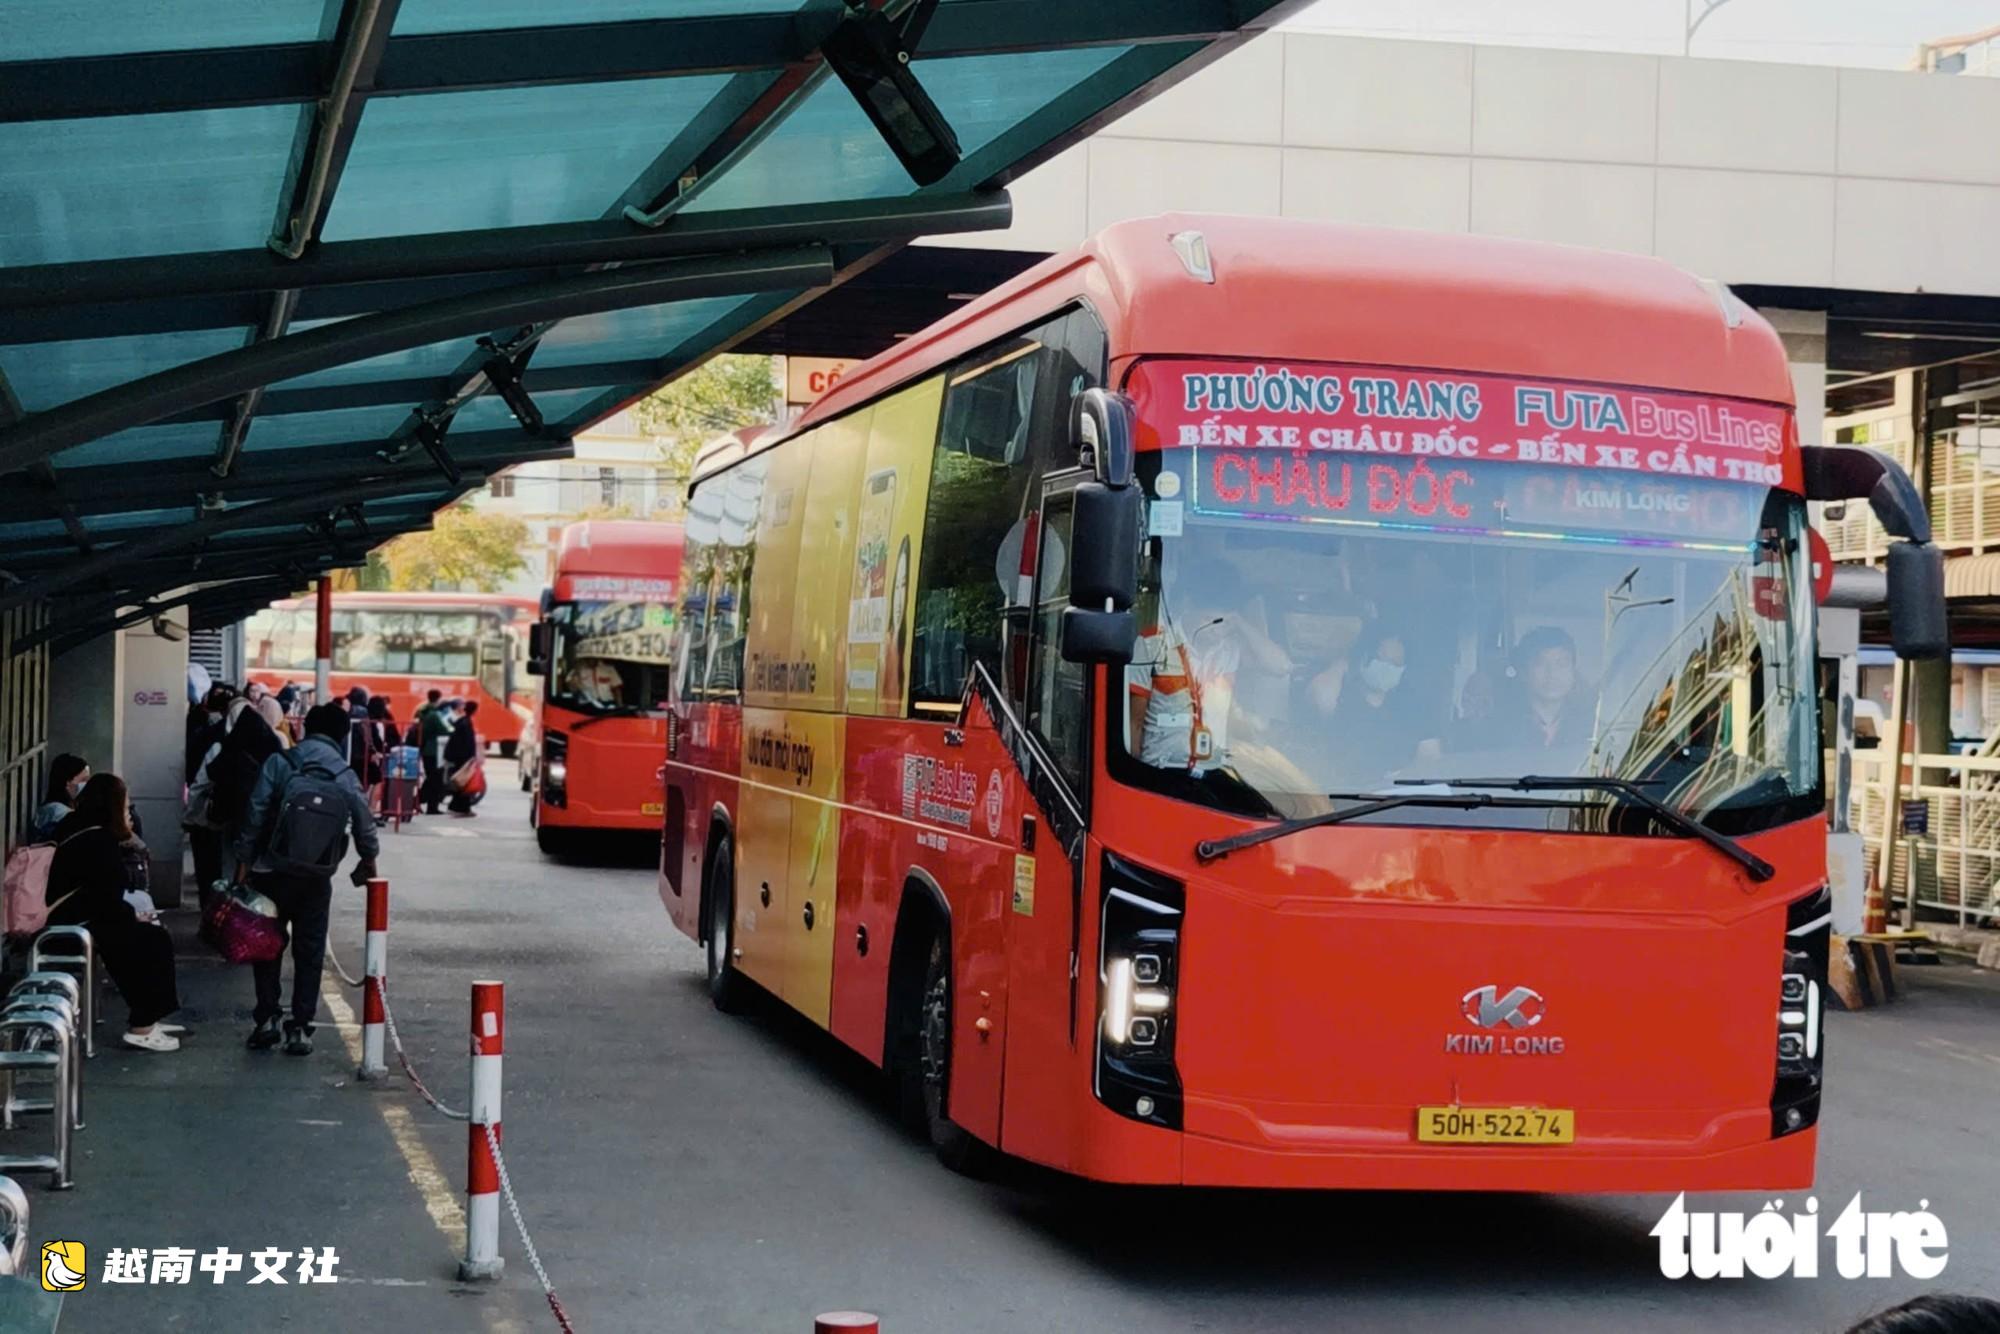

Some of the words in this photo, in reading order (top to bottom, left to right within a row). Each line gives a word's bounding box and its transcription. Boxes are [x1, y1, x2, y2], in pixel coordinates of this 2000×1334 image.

[1183, 367, 1343, 414] PHƯƠNG
[1350, 377, 1482, 421] TRANG
[1515, 386, 1630, 435] FUTA
[1631, 396, 1697, 442] Bus
[1697, 404, 1783, 454] Lines
[1178, 415, 1247, 446] BẾN
[1256, 425, 1301, 447] XE
[1309, 424, 1402, 452] CHÂU
[1411, 425, 1479, 457] ĐỐC
[1516, 432, 1588, 464] BẾN
[1595, 444, 1641, 470] XE
[1647, 444, 1716, 477] CẦN
[1723, 457, 1784, 485] THƠ
[1576, 489, 1620, 509] KIM
[1627, 491, 1690, 513] LONG
[1445, 1033, 1494, 1054] KIM
[1500, 1036, 1565, 1055] LONG
[1432, 1113, 1560, 1137] 50H-522.74
